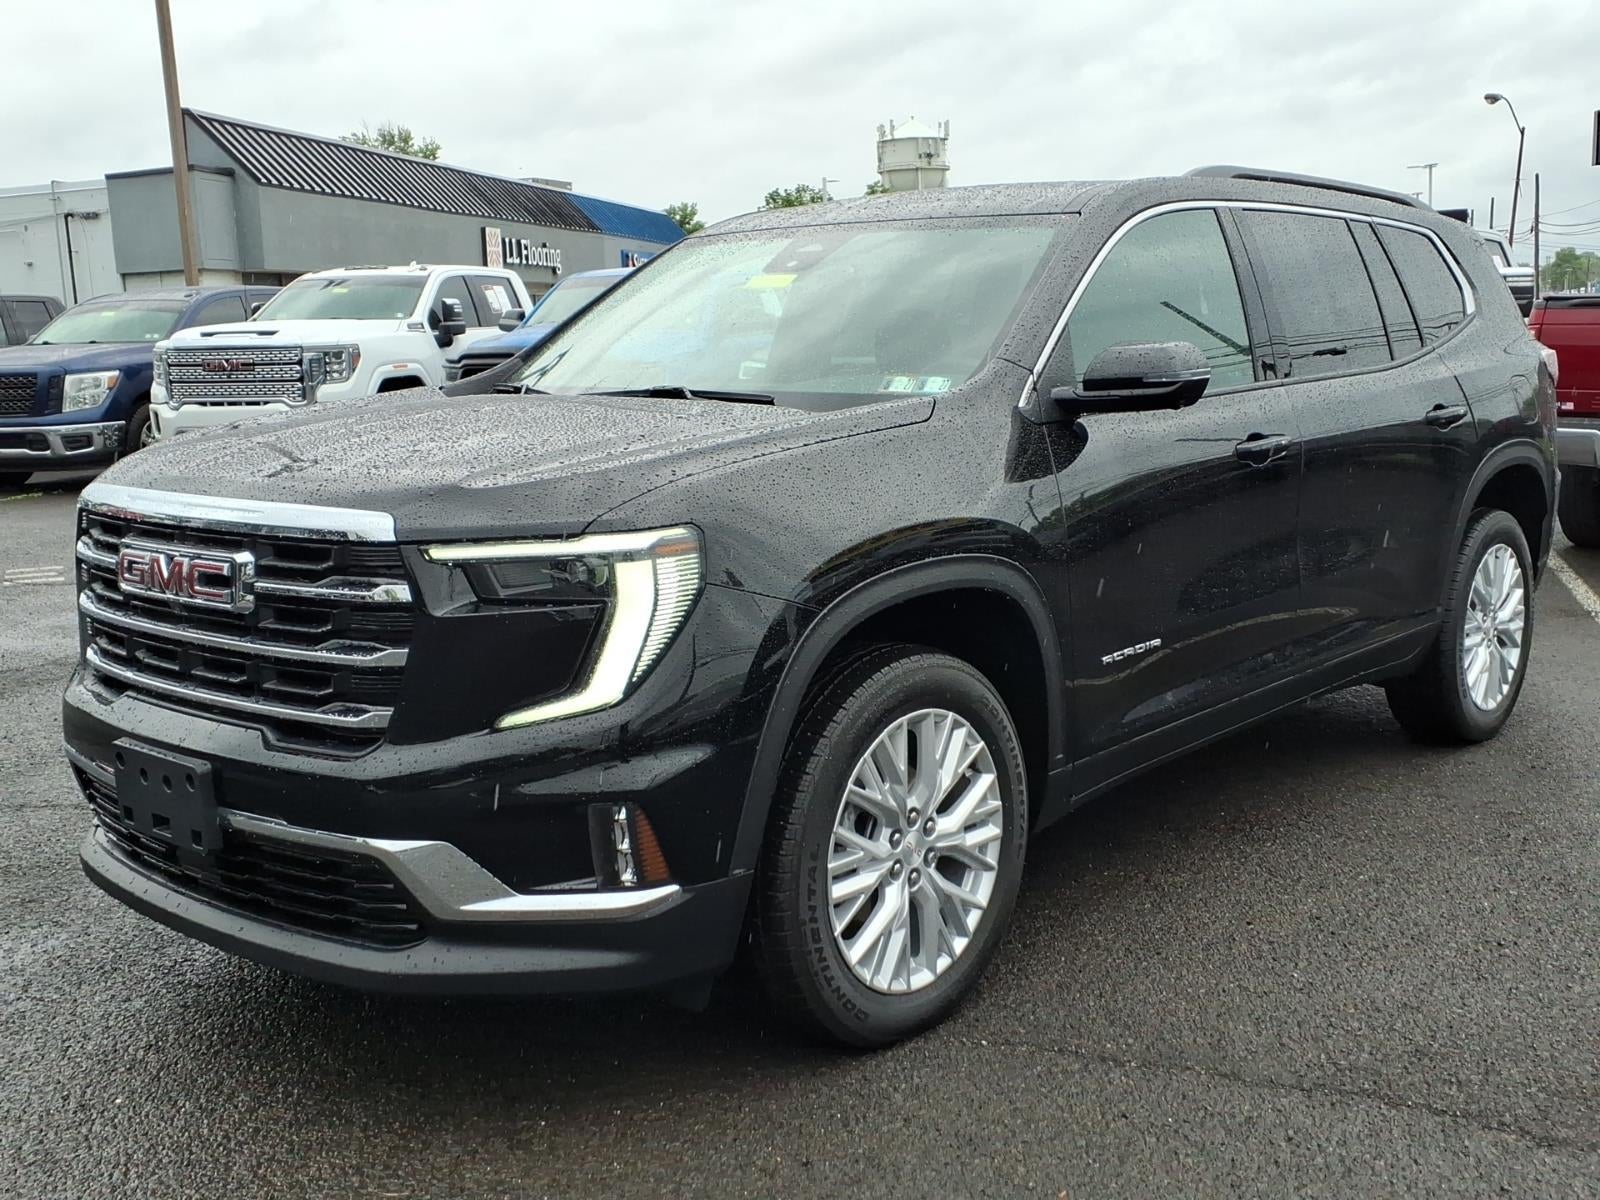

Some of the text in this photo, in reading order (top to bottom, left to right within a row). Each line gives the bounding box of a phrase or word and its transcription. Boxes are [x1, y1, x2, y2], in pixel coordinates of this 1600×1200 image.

[504, 236, 562, 275] LL Flooring
[202, 358, 254, 372] GMC
[119, 549, 233, 603] GMC
[1101, 638, 1162, 666] ACADIA
[806, 841, 871, 1023] CONTINENTAL
